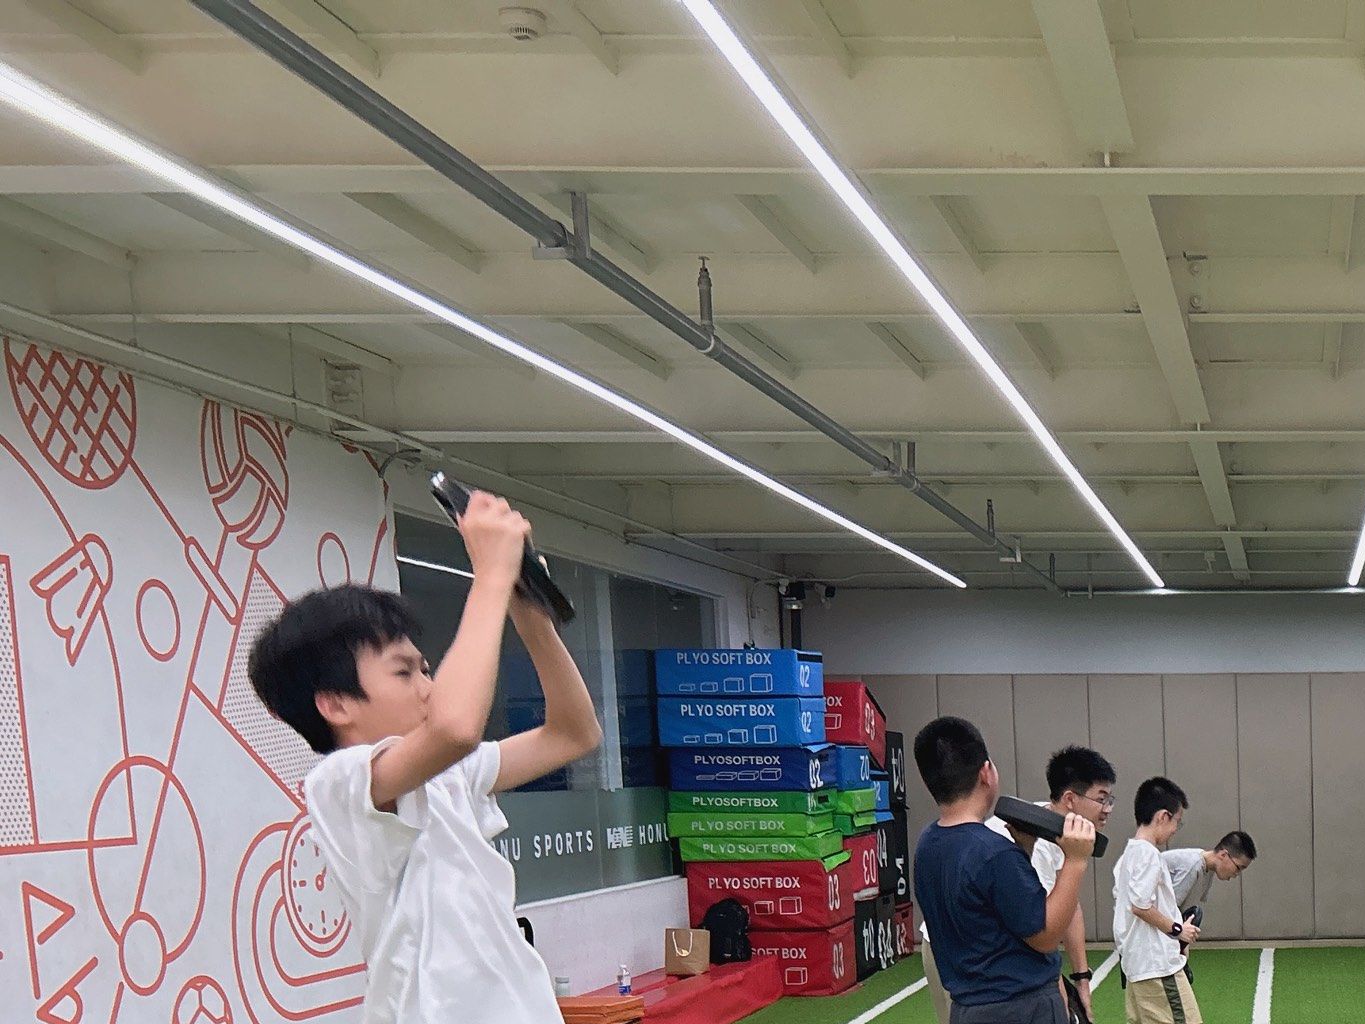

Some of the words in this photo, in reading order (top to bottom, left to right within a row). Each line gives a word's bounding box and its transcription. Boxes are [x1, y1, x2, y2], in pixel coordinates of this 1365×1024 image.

[677, 652, 709, 665] PLYO
[712, 652, 743, 665] SOFT
[746, 652, 771, 665] BOX
[800, 665, 810, 688] 02
[823, 696, 842, 707] OX
[681, 704, 713, 717] PLYO
[716, 704, 747, 717] SOFT
[749, 704, 775, 717] BOX
[801, 711, 811, 733] 02
[809, 758, 824, 789] 02
[691, 821, 724, 831] PLYO
[726, 821, 757, 831] SOFT
[760, 821, 785, 831] BOX
[533, 830, 594, 859] SPORTS
[703, 844, 736, 854] PLYO
[738, 844, 769, 854] SOFT
[771, 844, 797, 854] BOX
[708, 877, 740, 889] PLYO
[743, 877, 773, 889] SOFT
[775, 877, 801, 889] BOX
[828, 874, 840, 911] 03
[781, 947, 807, 959] BOX
[833, 942, 845, 979] 03
